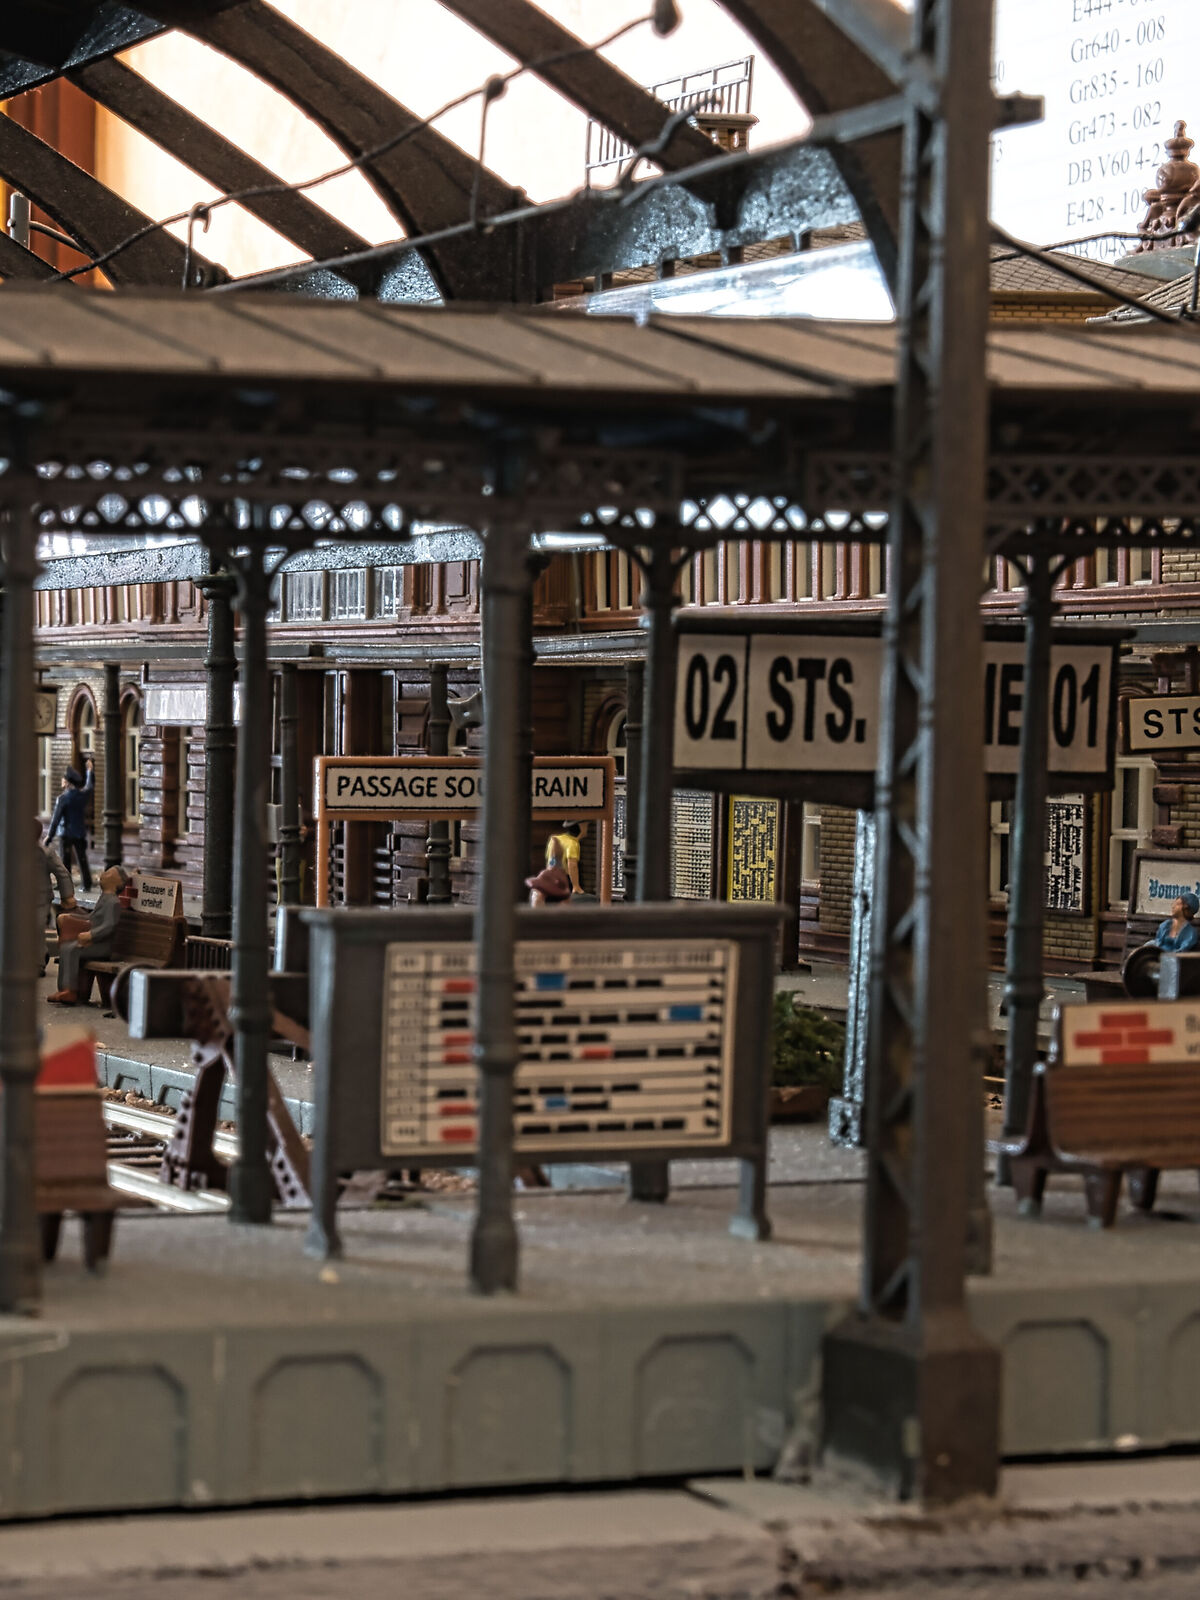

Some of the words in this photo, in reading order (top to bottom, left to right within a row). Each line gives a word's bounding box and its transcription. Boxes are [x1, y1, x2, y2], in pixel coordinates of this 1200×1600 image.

[1070, 28, 1120, 63] Gr640
[1136, 15, 1166, 46] 008
[1069, 69, 1119, 104] Gr835
[1136, 57, 1164, 88] 160
[1068, 112, 1116, 145] Gr473
[1133, 101, 1162, 130] 082
[1067, 159, 1092, 186] DB
[1098, 149, 1130, 178] V60
[1134, 142, 1162, 171] 4-2
[1066, 196, 1104, 227] E428
[685, 653, 738, 741] 02
[766, 655, 867, 744] STS.
[1052, 663, 1101, 748] 01
[337, 775, 438, 798] PASSAGE
[444, 775, 589, 798] SORAIN
